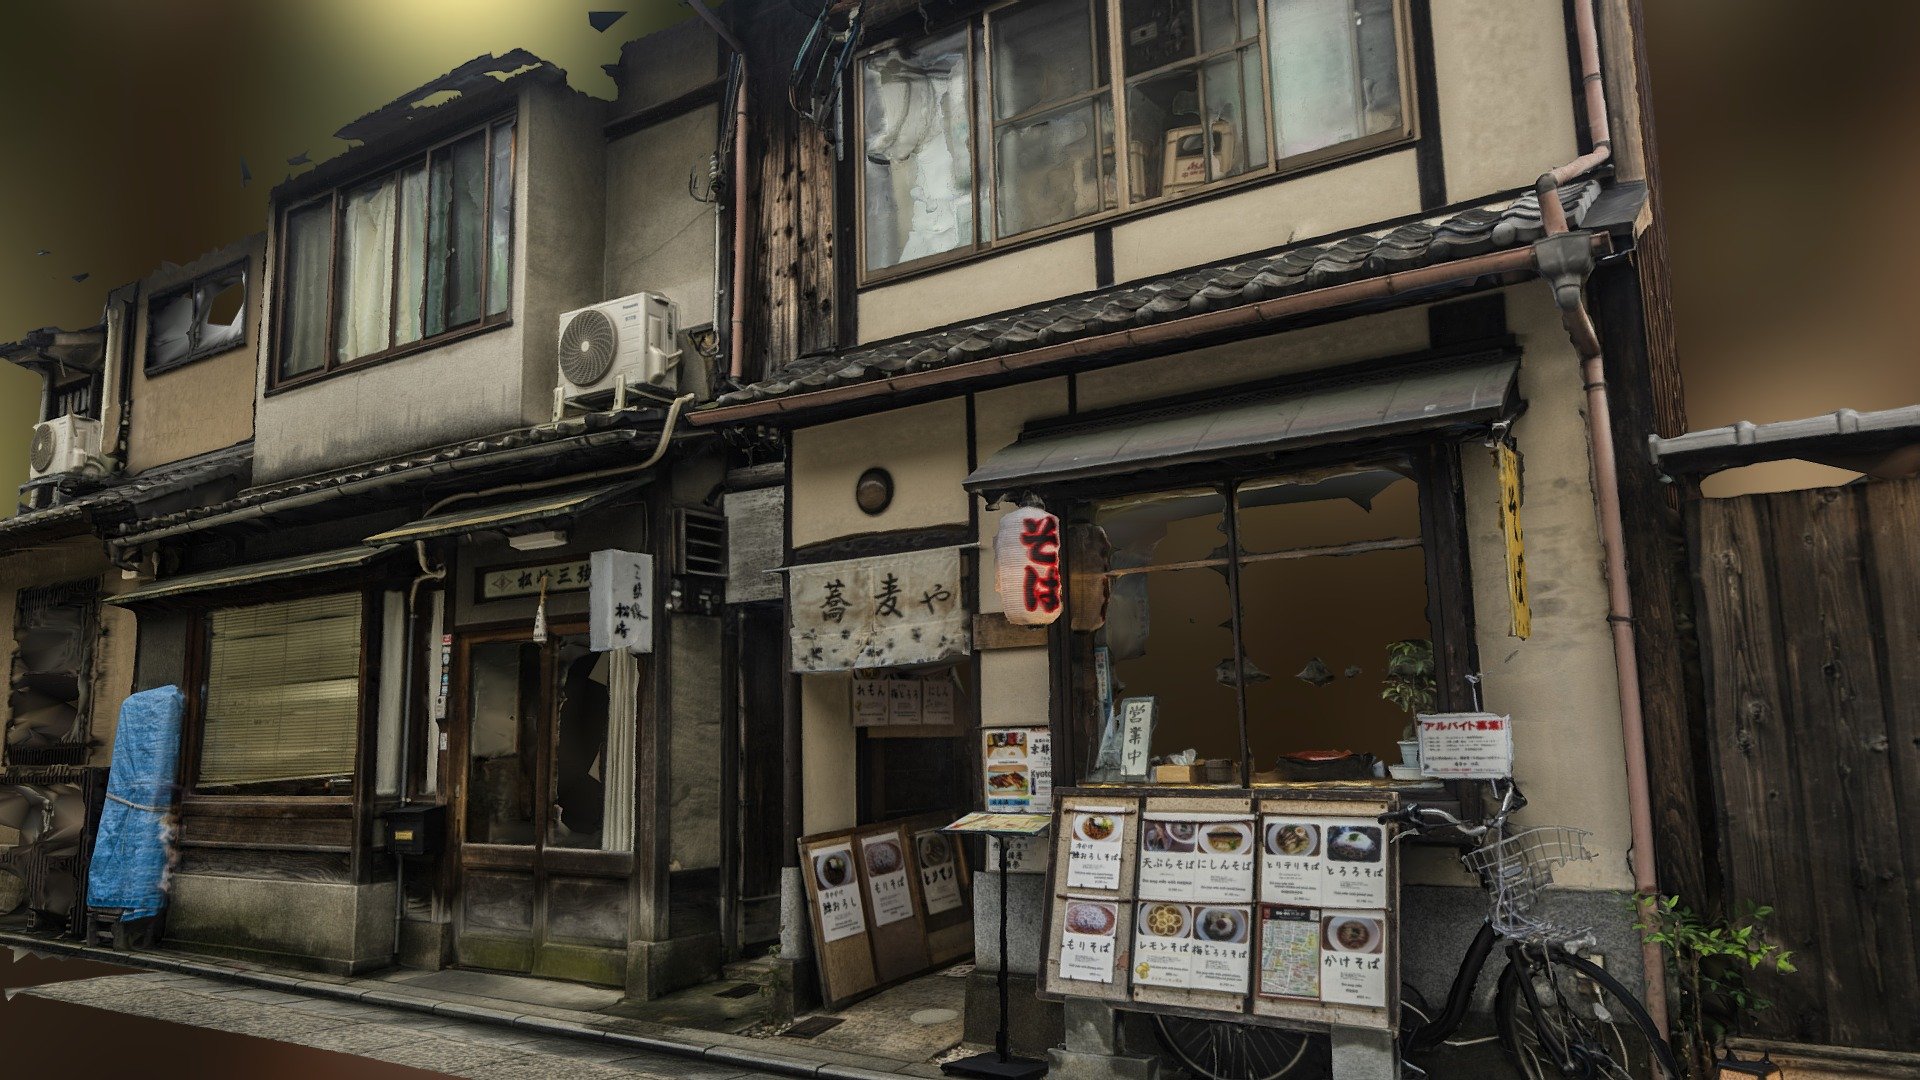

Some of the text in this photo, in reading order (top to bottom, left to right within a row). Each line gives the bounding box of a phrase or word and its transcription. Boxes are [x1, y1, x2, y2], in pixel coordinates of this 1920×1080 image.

[1020, 515, 1060, 614] そば
[820, 572, 950, 623] 蕎麦や
[1129, 704, 1146, 766] 営業中
[1142, 858, 1194, 870] 天ぷらそば
[1197, 859, 1252, 871] にしんそば
[1326, 866, 1384, 877] とろろそば
[1067, 939, 1111, 953] もりそば
[1139, 941, 1190, 953] レモンそば
[1324, 955, 1380, 970] かけそば
